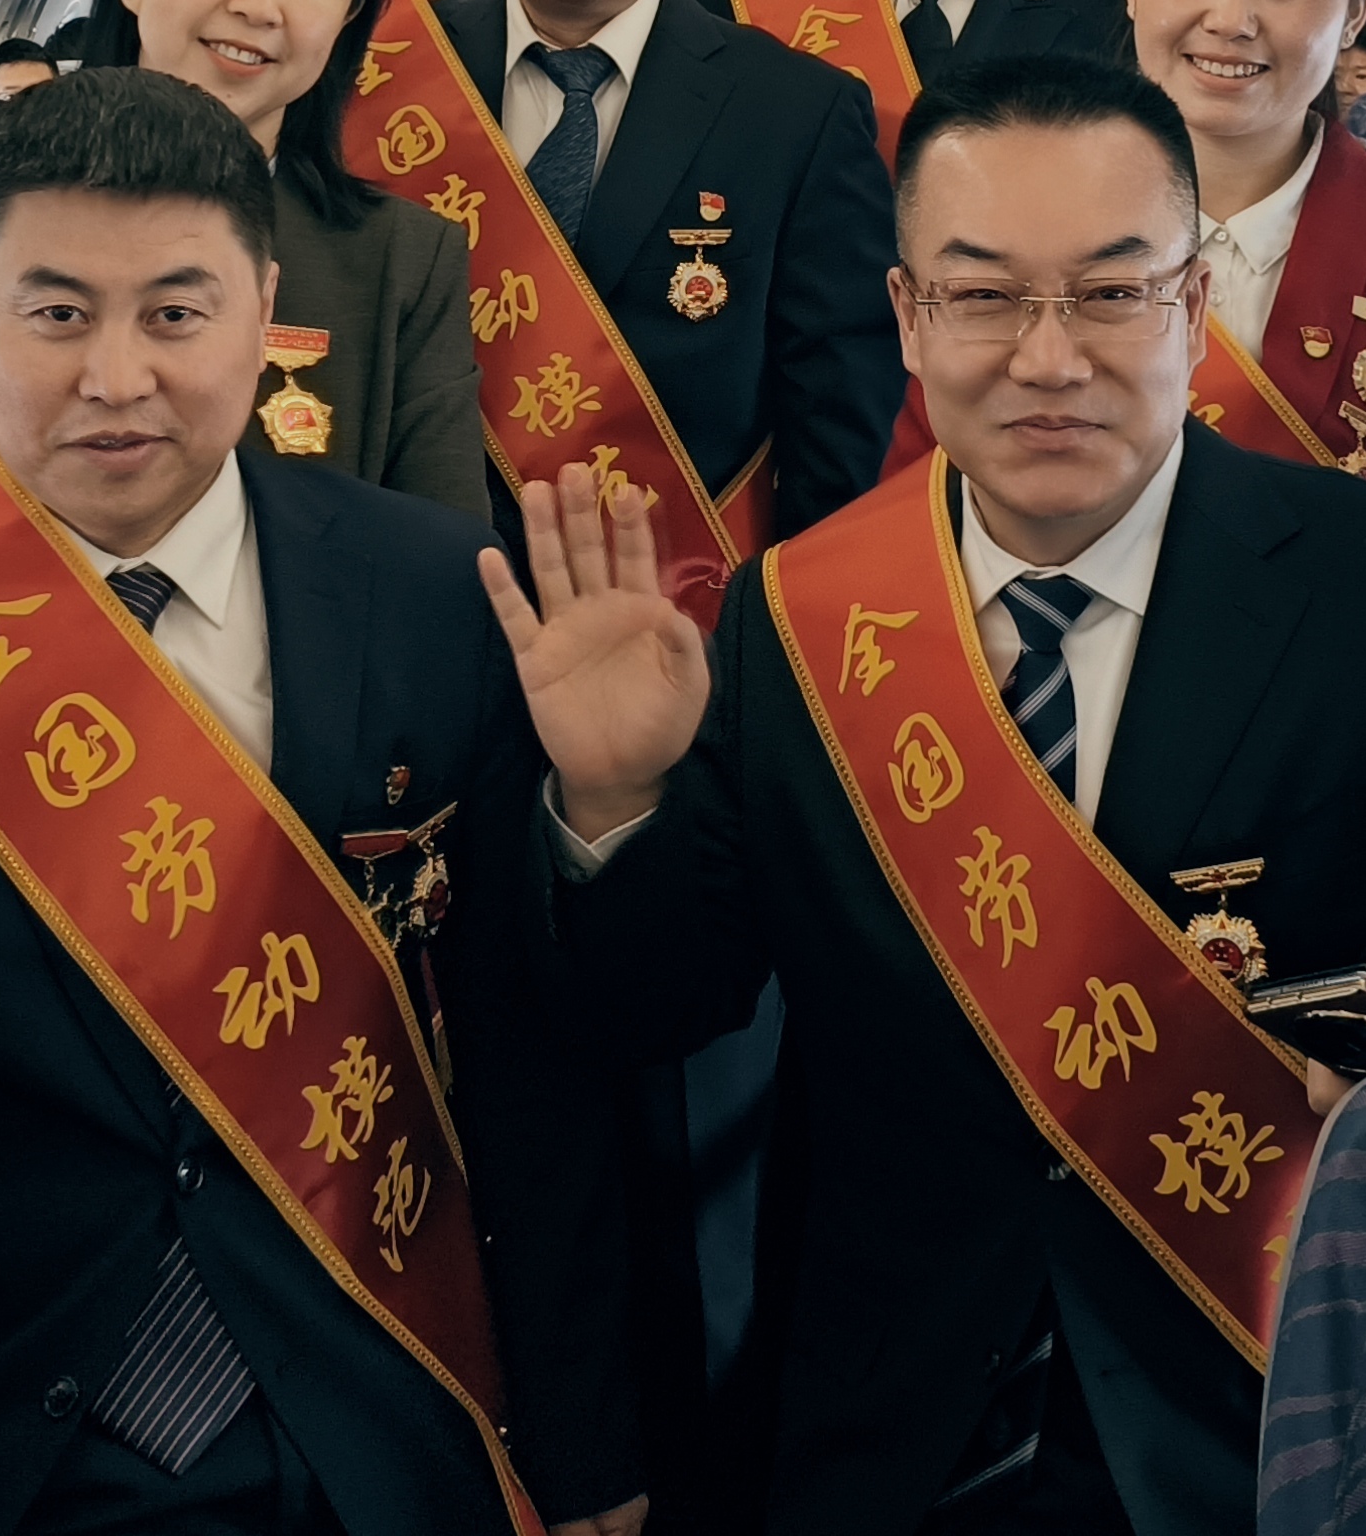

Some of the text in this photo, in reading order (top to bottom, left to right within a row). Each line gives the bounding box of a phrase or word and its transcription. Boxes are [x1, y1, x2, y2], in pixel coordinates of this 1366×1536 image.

[837, 602, 1291, 1284] 全国劳动模
